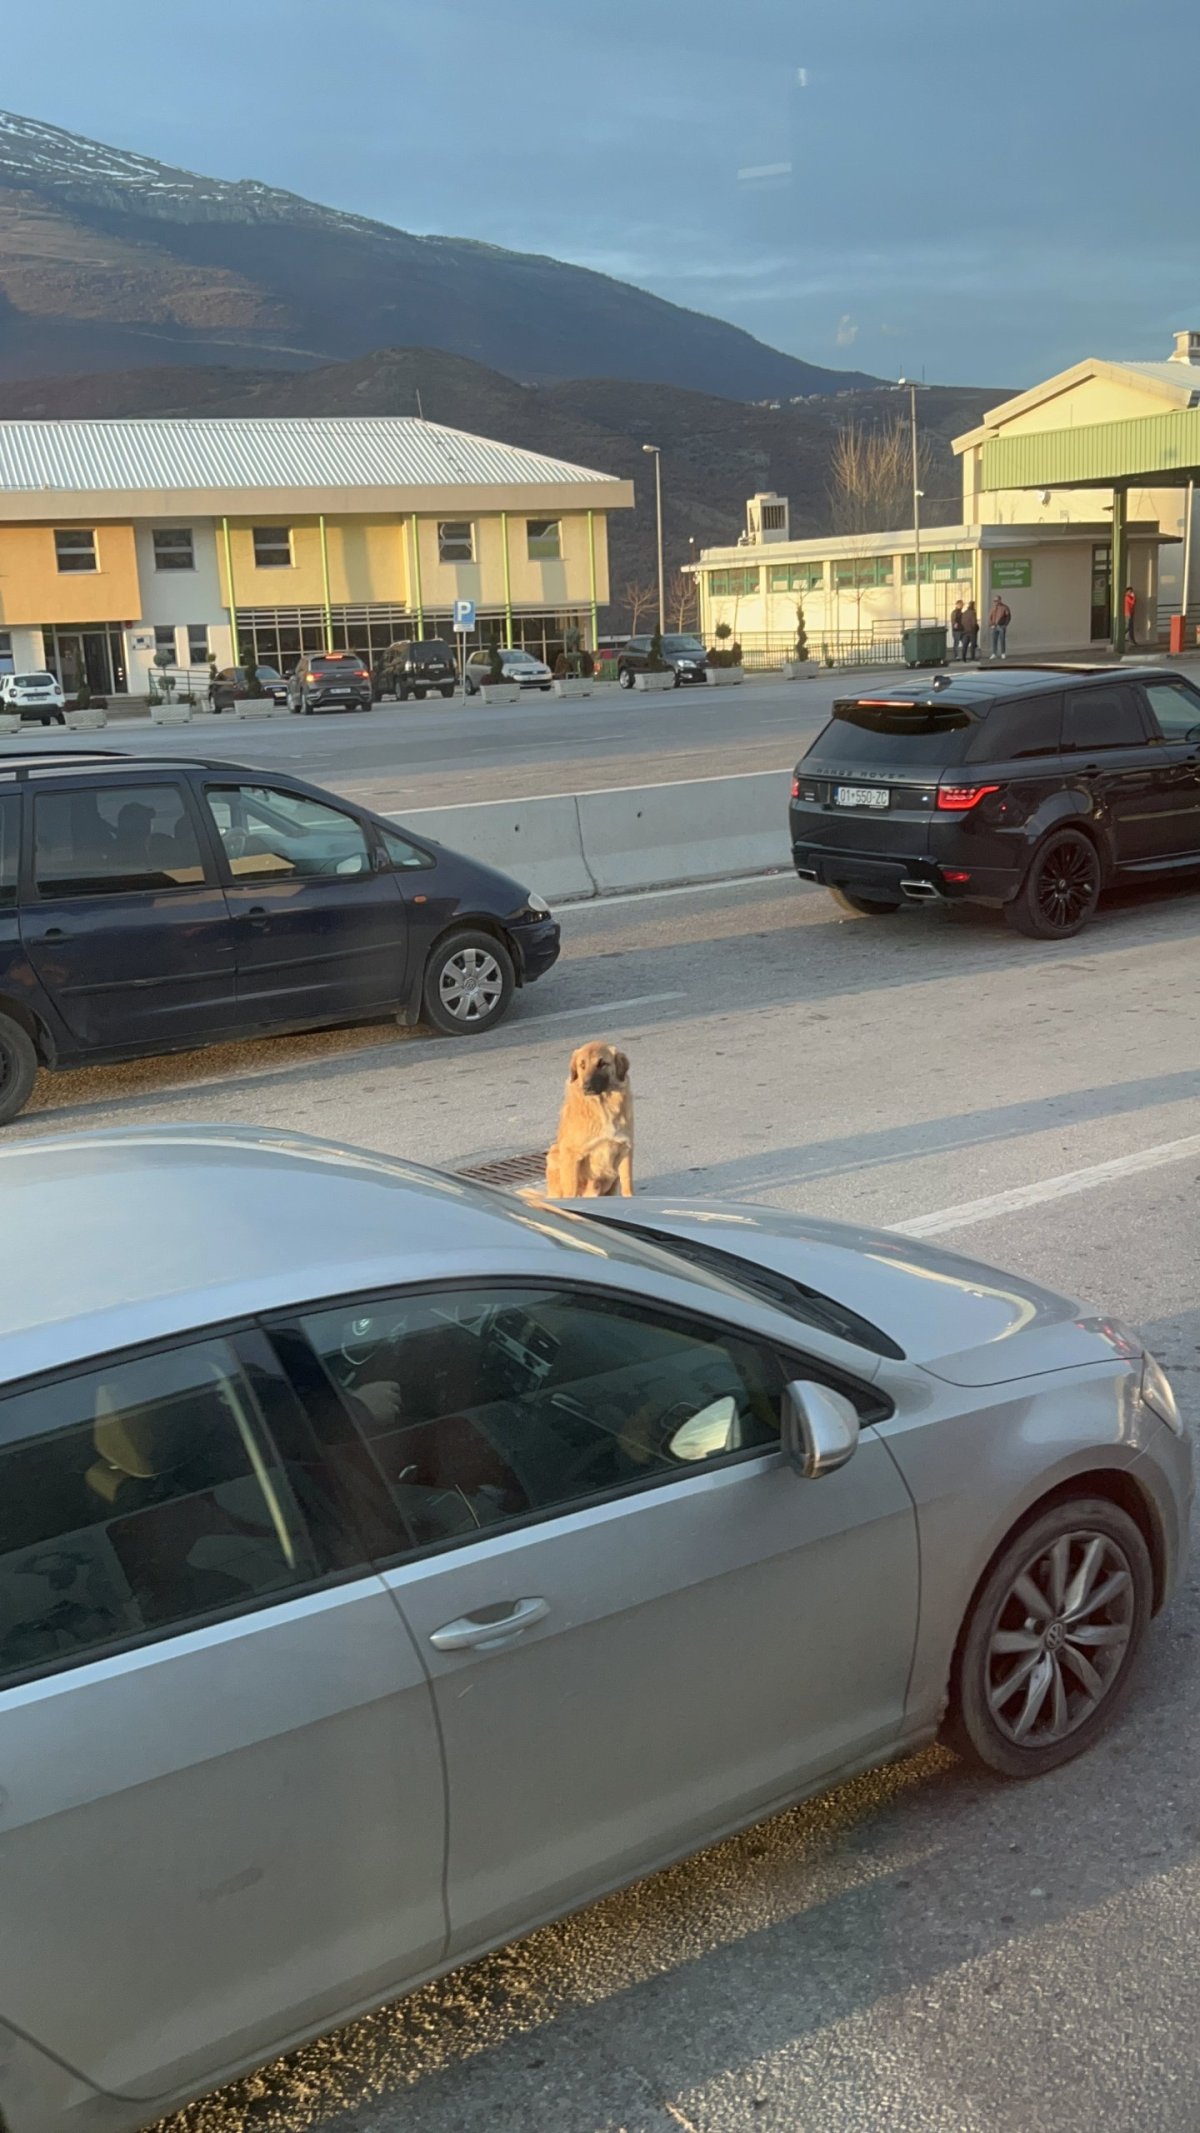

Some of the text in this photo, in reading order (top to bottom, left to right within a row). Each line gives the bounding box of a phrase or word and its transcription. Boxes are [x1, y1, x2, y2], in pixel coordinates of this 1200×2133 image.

[457, 601, 471, 621] P
[816, 768, 906, 779] RANGE ROVER
